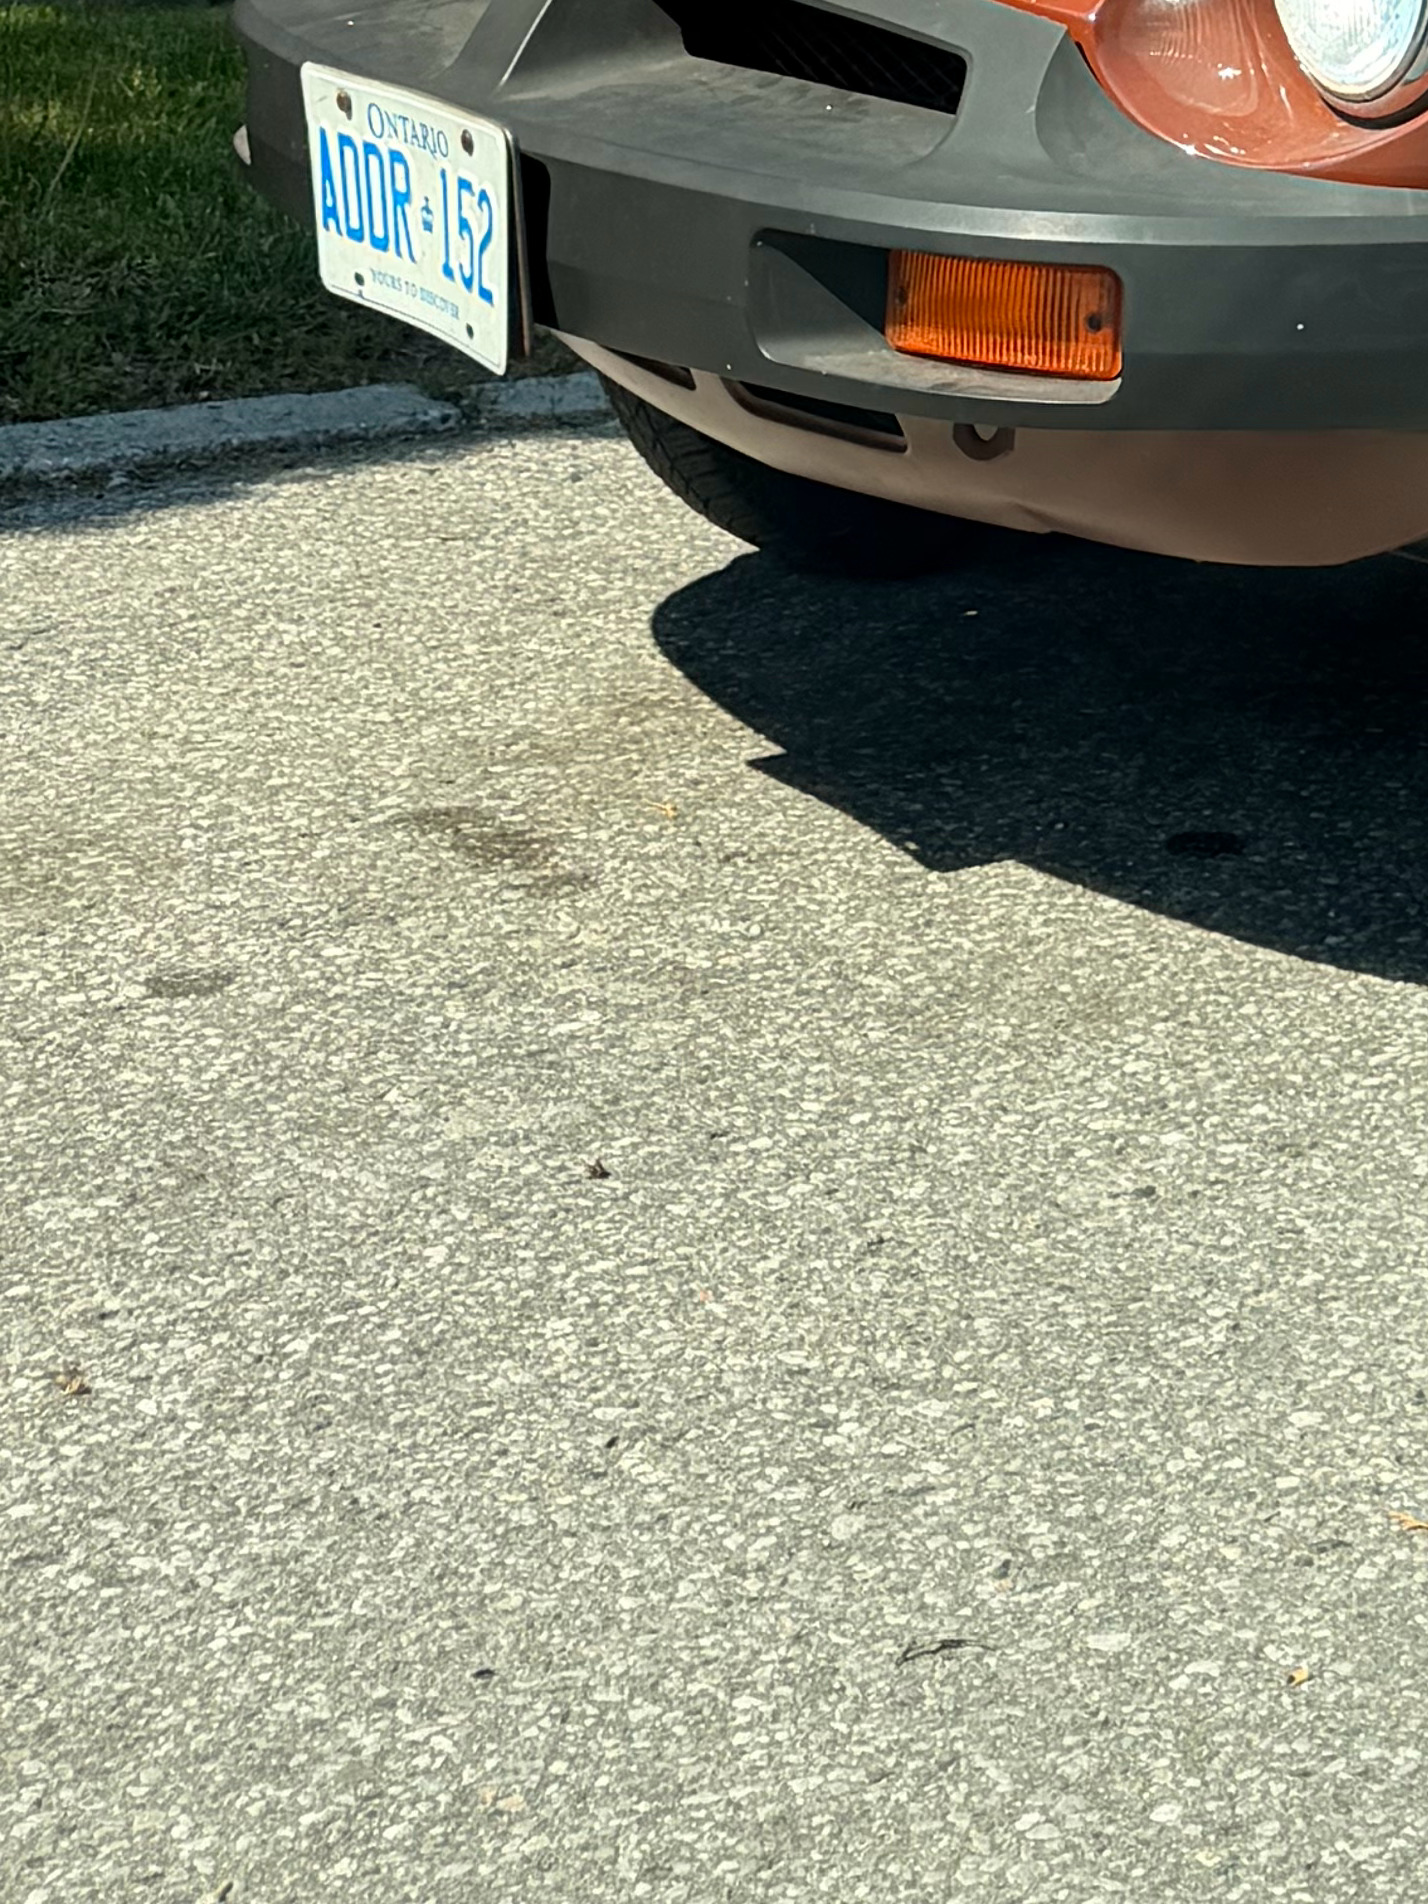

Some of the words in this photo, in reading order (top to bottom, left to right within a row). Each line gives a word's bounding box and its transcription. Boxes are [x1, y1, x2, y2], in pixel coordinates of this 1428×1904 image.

[367, 102, 449, 160] ONTARIO
[319, 126, 417, 265] ADDR
[439, 166, 495, 308] 152
[368, 265, 403, 293] YOURS
[404, 279, 418, 298] TO
[419, 286, 461, 321] DISCOVER
